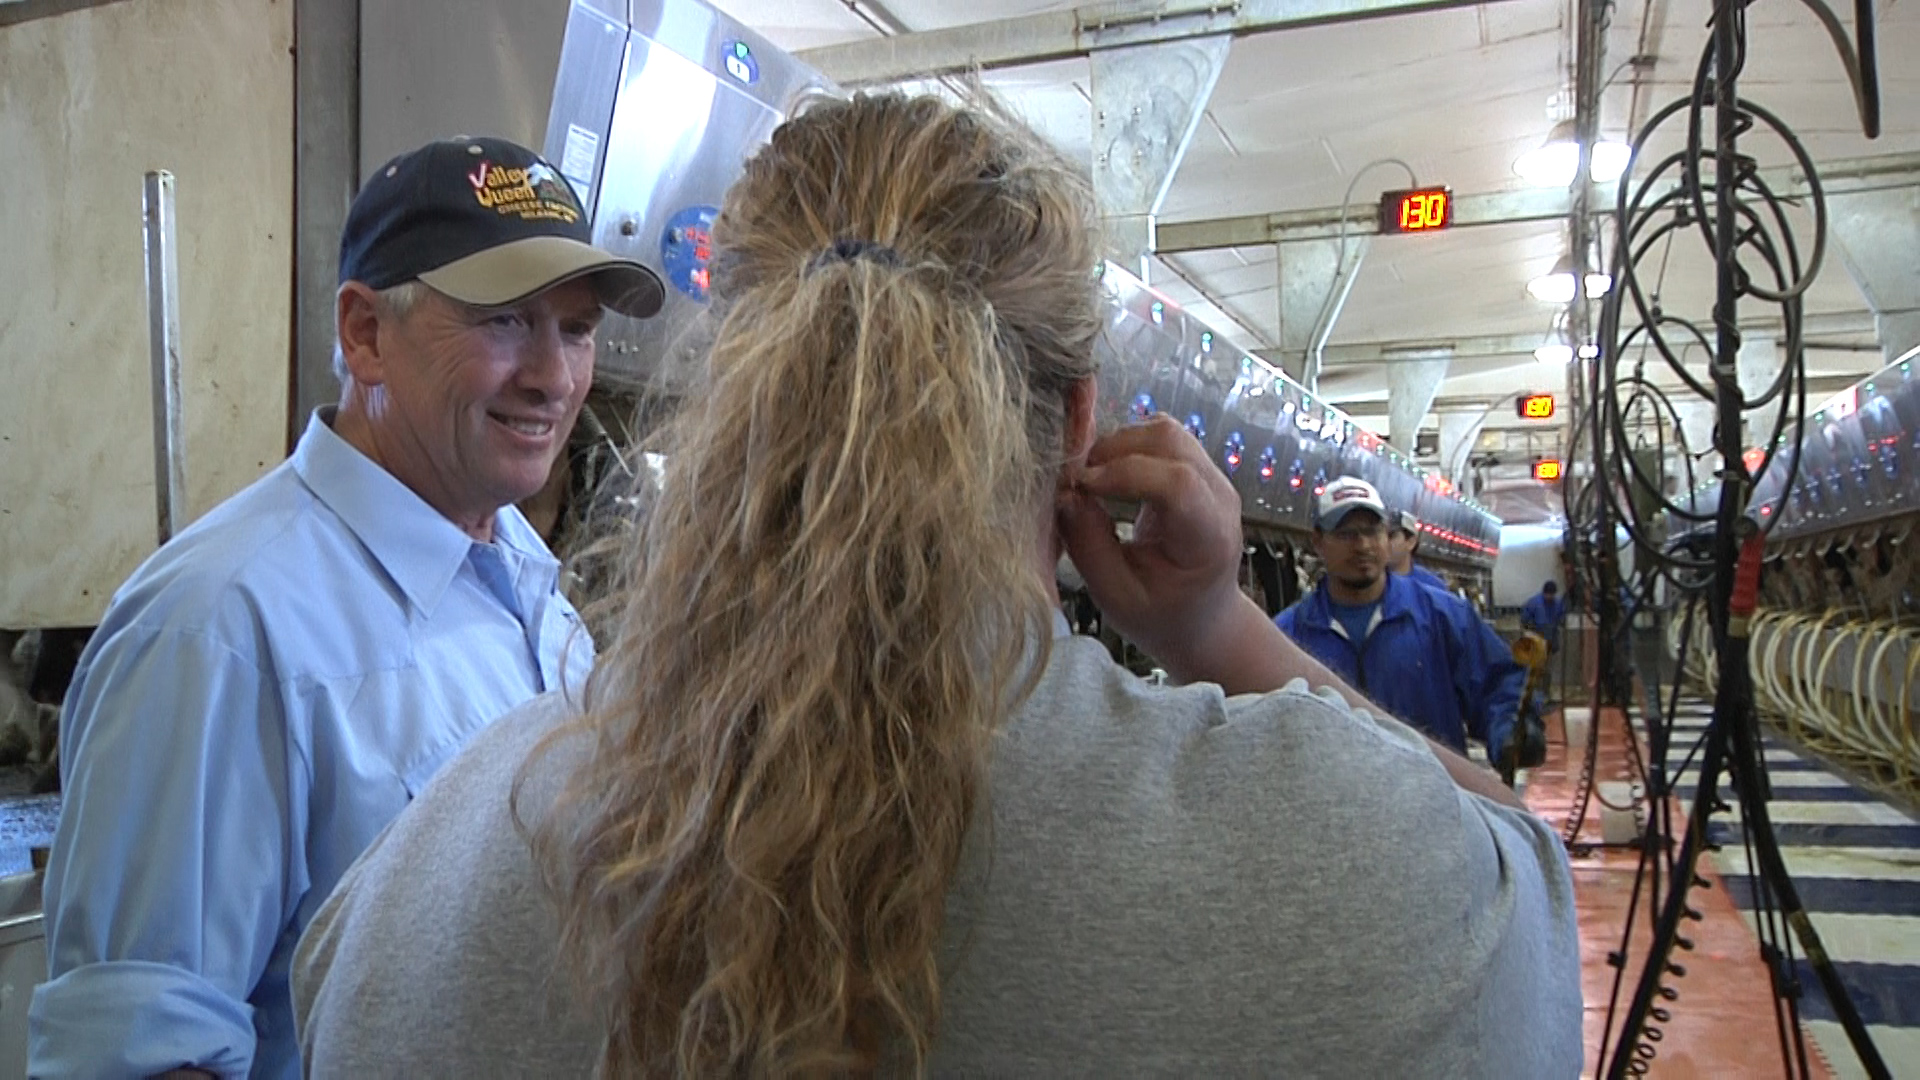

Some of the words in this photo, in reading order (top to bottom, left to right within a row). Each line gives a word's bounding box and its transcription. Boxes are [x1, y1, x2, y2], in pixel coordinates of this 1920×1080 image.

[467, 162, 530, 188] Valley
[475, 186, 537, 208] Queen
[1401, 193, 1444, 228] 130
[1526, 397, 1551, 416] 130
